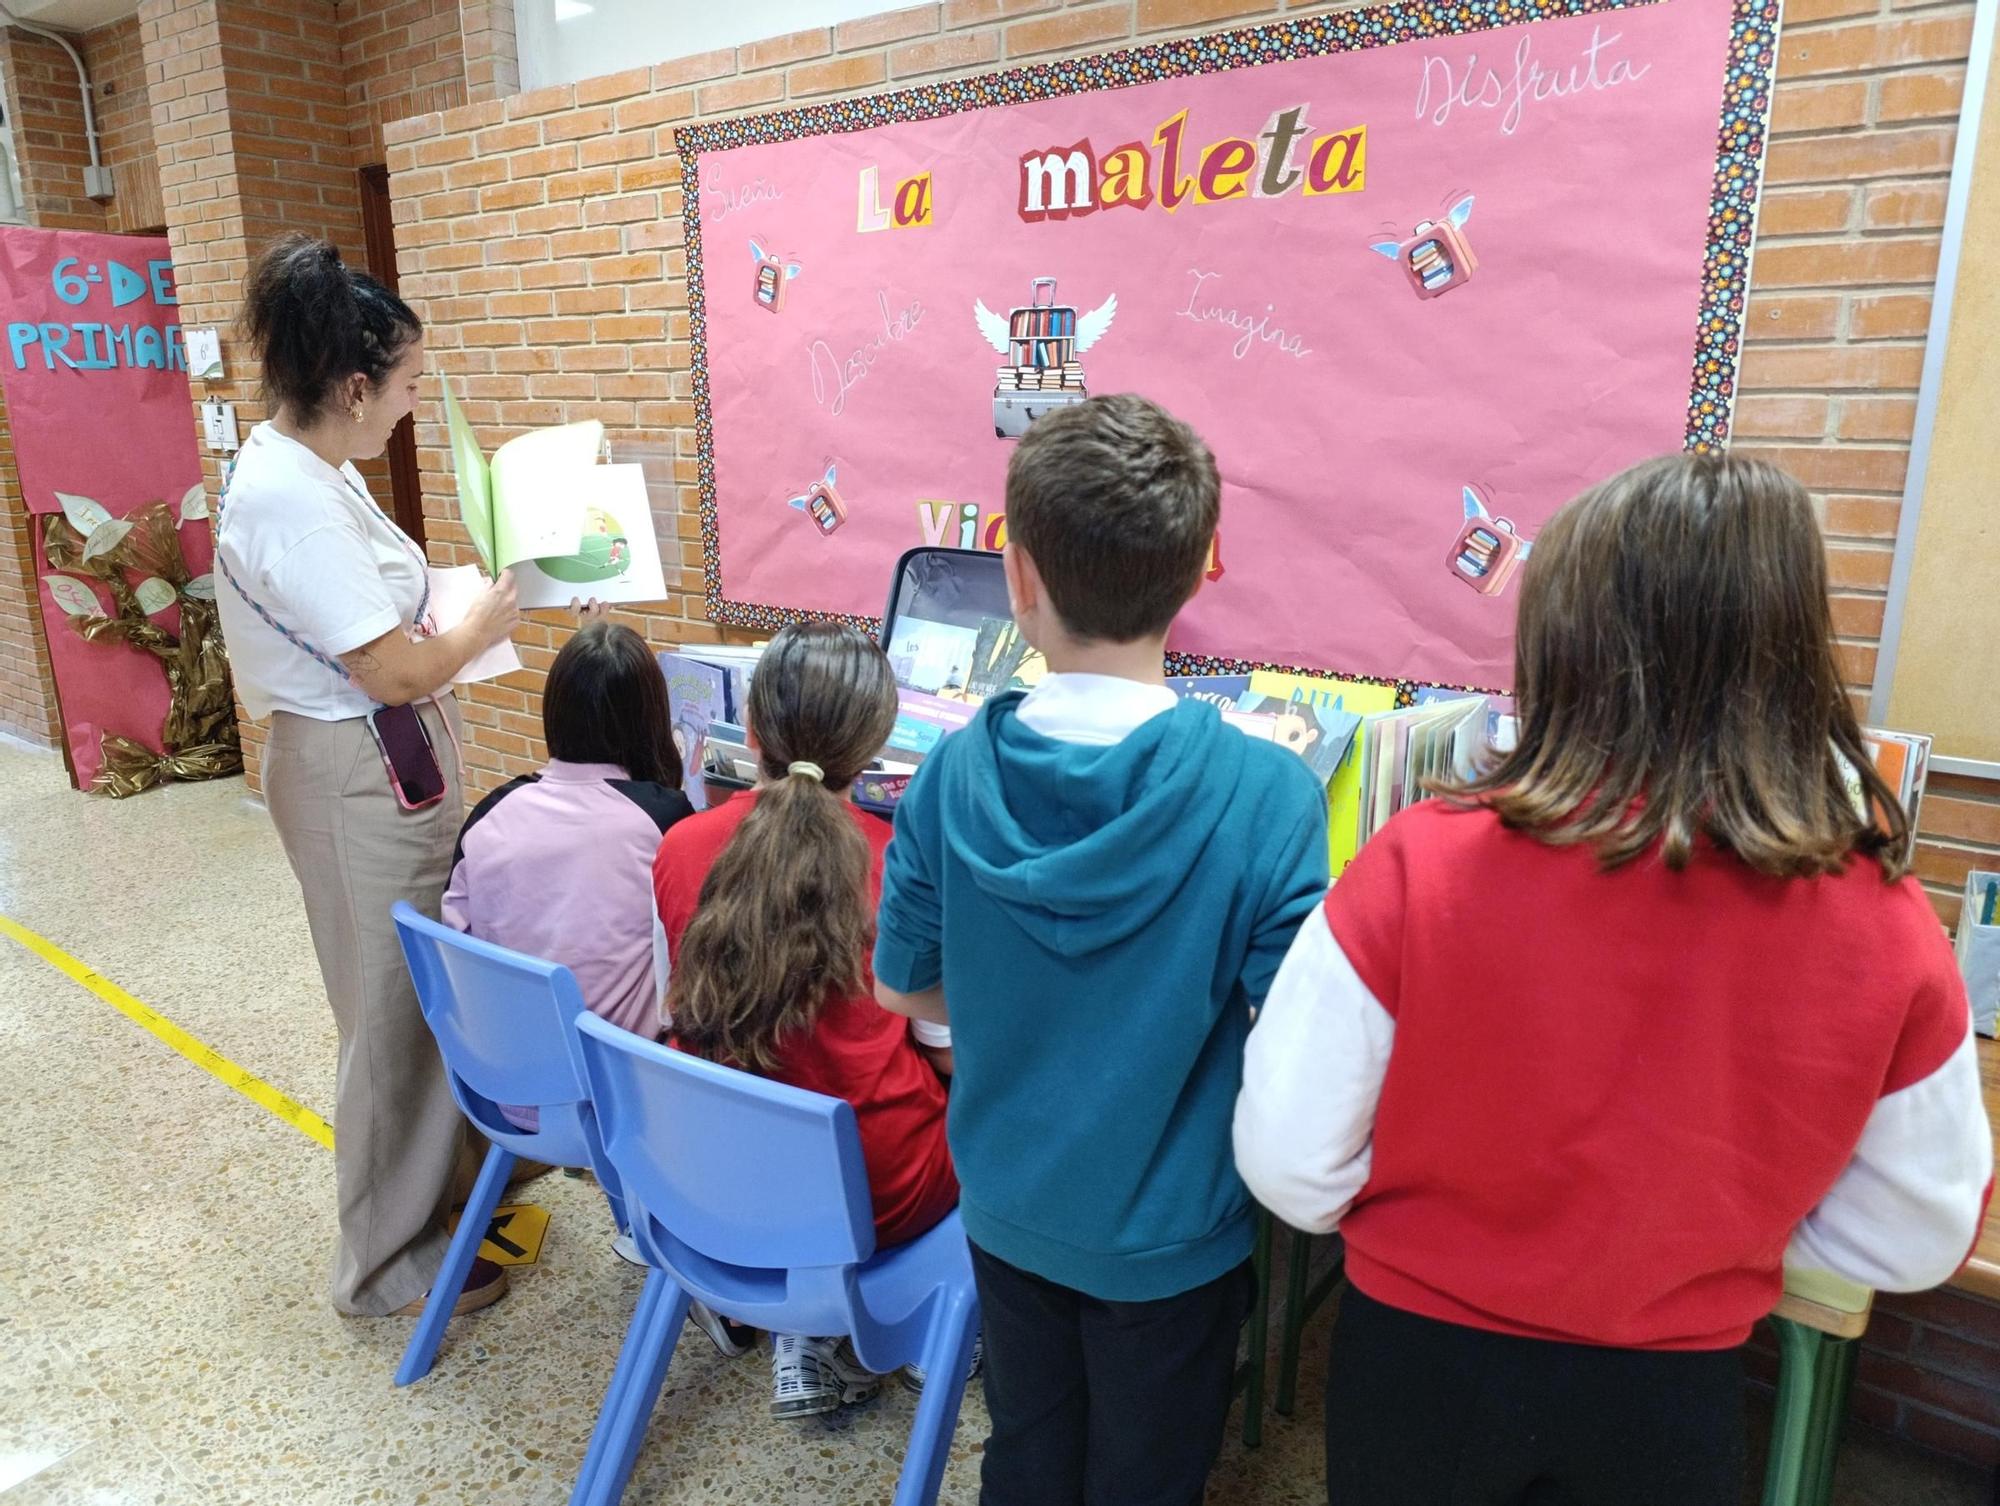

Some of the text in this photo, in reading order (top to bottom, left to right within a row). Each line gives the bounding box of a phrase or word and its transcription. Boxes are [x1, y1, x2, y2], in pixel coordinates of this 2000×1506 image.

[1416, 25, 1652, 135] Disfruta
[707, 163, 783, 222] Sueña
[857, 103, 1367, 233] La maleta
[107, 260, 178, 307] DE
[1176, 268, 1313, 359] Imagina
[806, 290, 926, 416] Descubre
